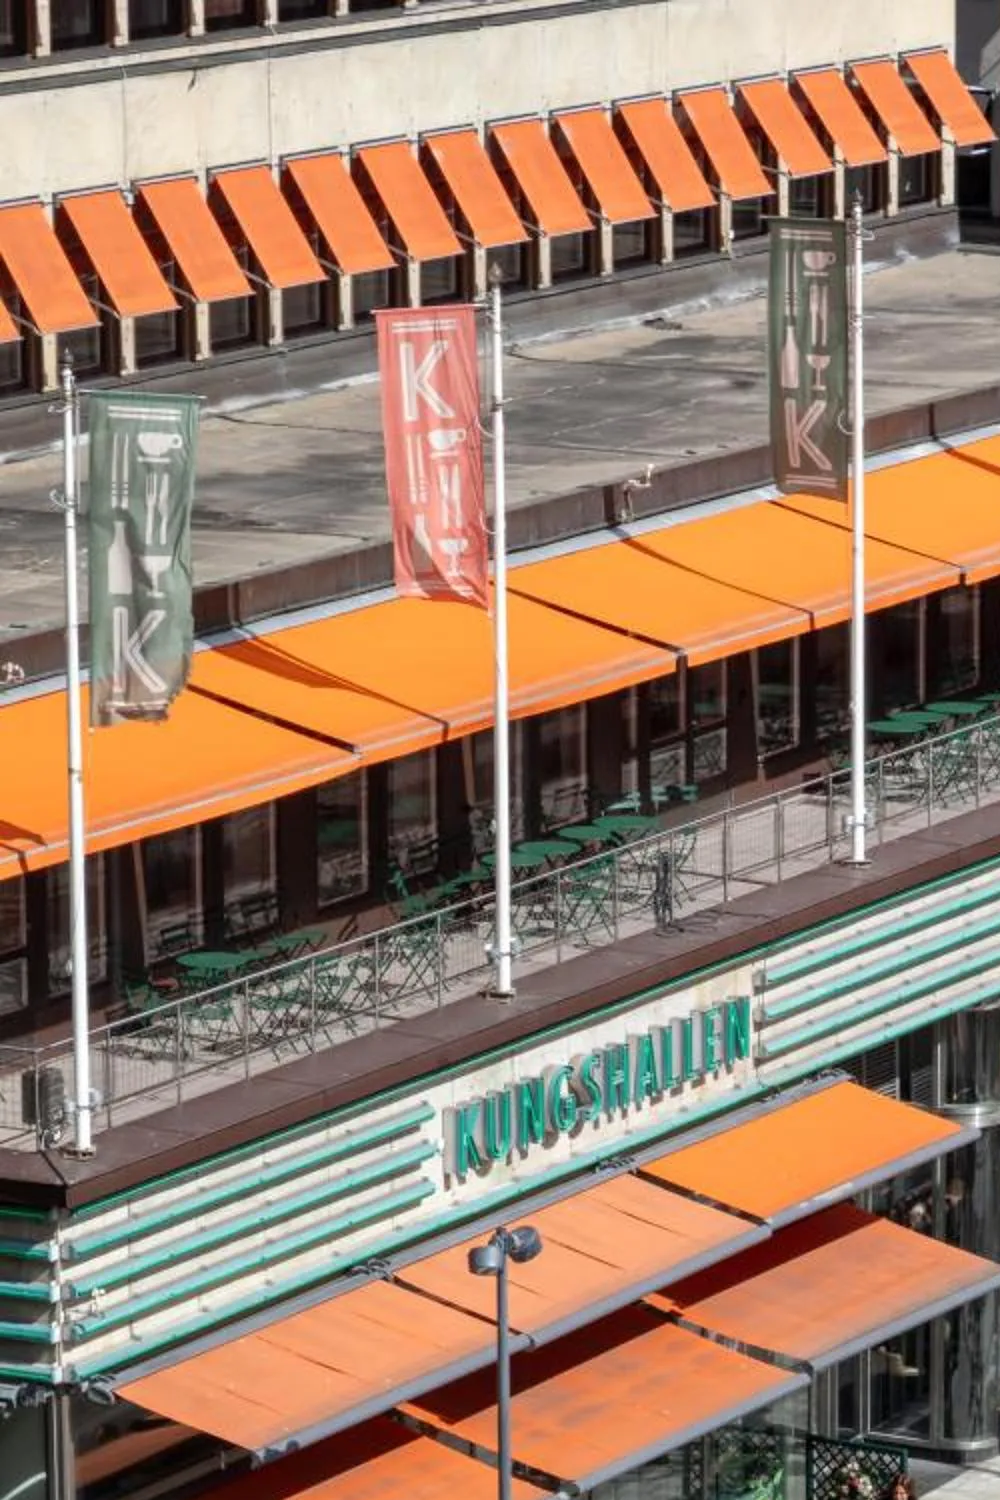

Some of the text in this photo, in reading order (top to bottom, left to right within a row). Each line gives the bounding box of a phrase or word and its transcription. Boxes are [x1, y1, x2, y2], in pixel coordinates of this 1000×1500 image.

[399, 340, 456, 422] K
[784, 398, 832, 470] K
[112, 606, 168, 694] K
[452, 997, 750, 1182] KUNGSHALLEN
